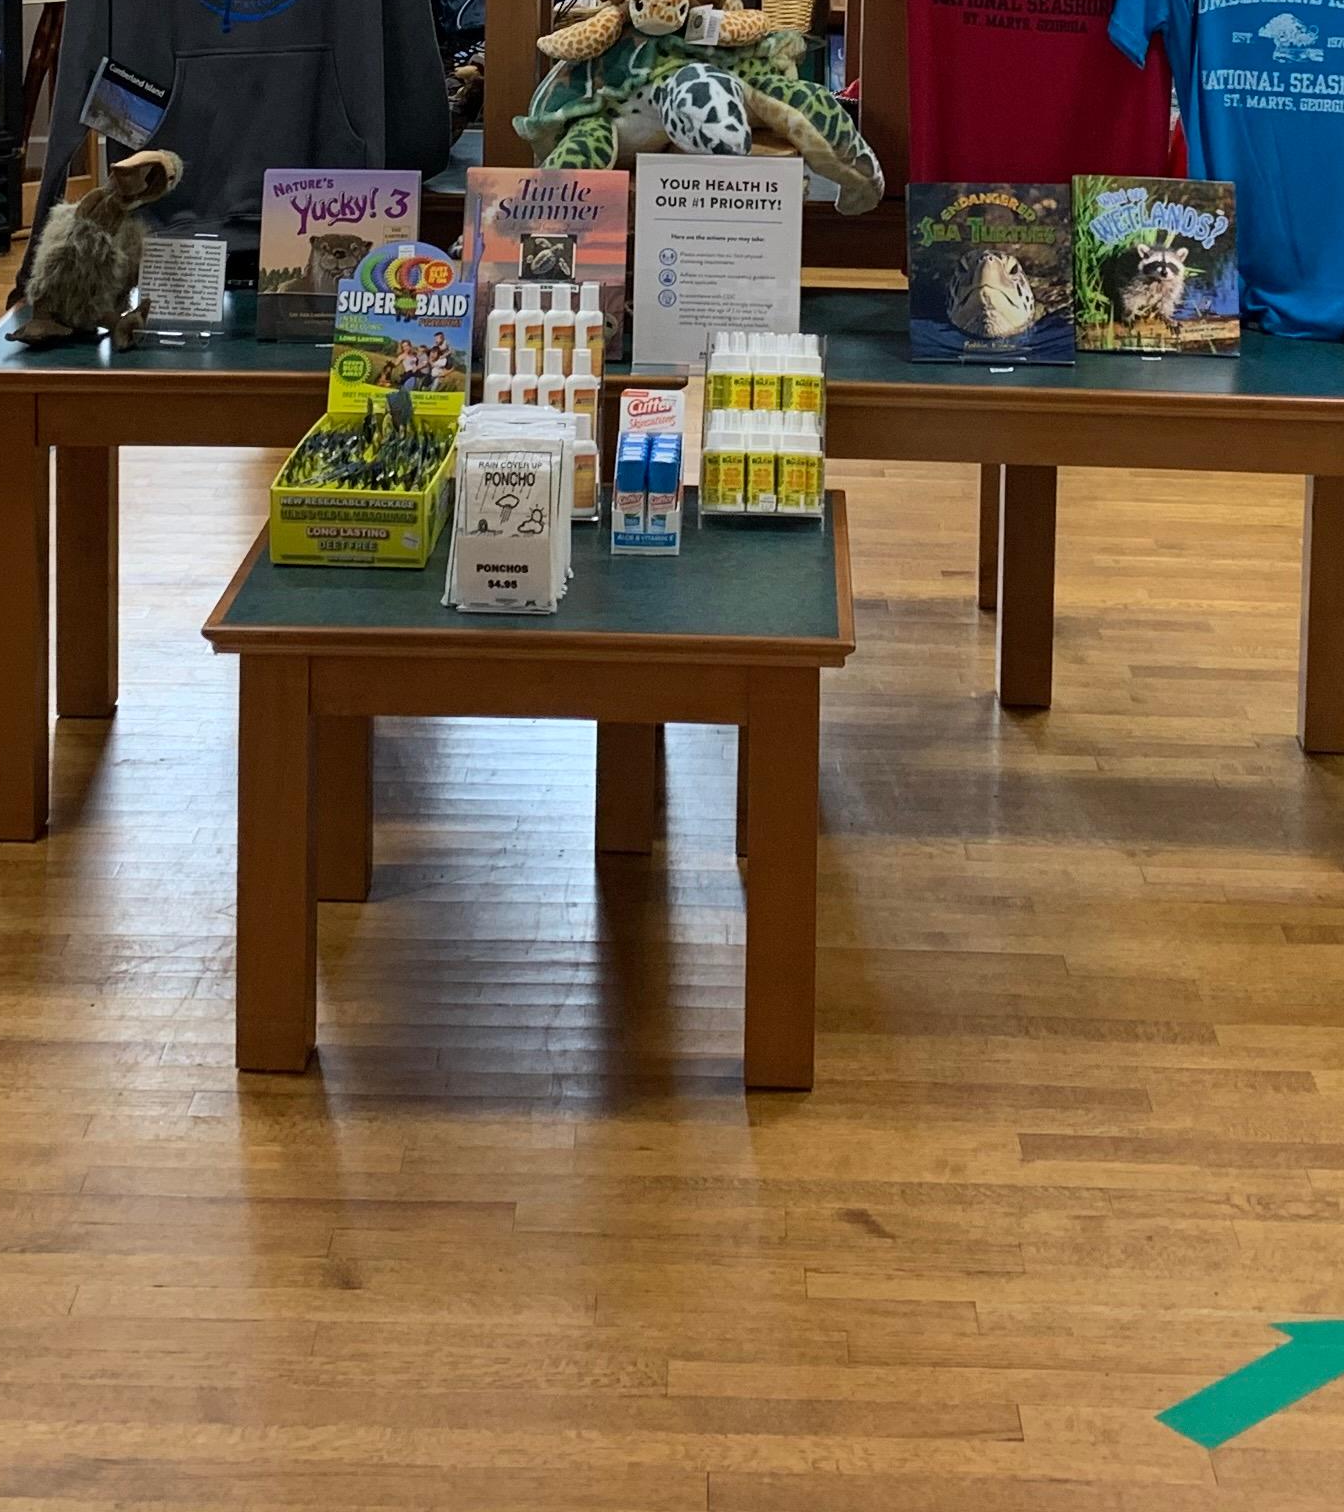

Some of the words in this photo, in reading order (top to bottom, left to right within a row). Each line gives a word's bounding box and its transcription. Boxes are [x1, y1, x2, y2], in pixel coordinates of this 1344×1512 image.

[109, 63, 146, 88] Cumberland
[144, 81, 165, 98] Island
[1223, 94, 1243, 108] ST.
[273, 177, 335, 198] NATURE'S
[518, 178, 591, 202] Turtle
[659, 178, 701, 191] YOUR
[705, 179, 761, 193] HEALTH
[766, 181, 779, 193] IS
[290, 187, 379, 236] Yucky!
[384, 188, 411, 219] 3
[496, 198, 606, 221] Summer
[655, 196, 687, 208] OUR
[692, 197, 705, 209] #1
[710, 197, 782, 211] PRIORITY!
[941, 192, 1038, 223] ENDANGERED
[1089, 201, 1230, 250] WETLANDS?
[337, 290, 397, 316] SUPER
[414, 294, 468, 317] BAND
[627, 396, 674, 416] Cutter
[478, 461, 498, 469] RAIN
[499, 461, 529, 470] COVER
[531, 462, 543, 470] UP
[484, 471, 536, 487] PONCHO
[280, 496, 303, 505] NEW
[305, 497, 367, 507] RESEALABLE
[369, 499, 415, 509] PACKAGE
[307, 526, 337, 536] LONG
[339, 528, 388, 538] LASTING
[348, 542, 377, 552] FREE
[476, 563, 529, 574] PONCHOS
